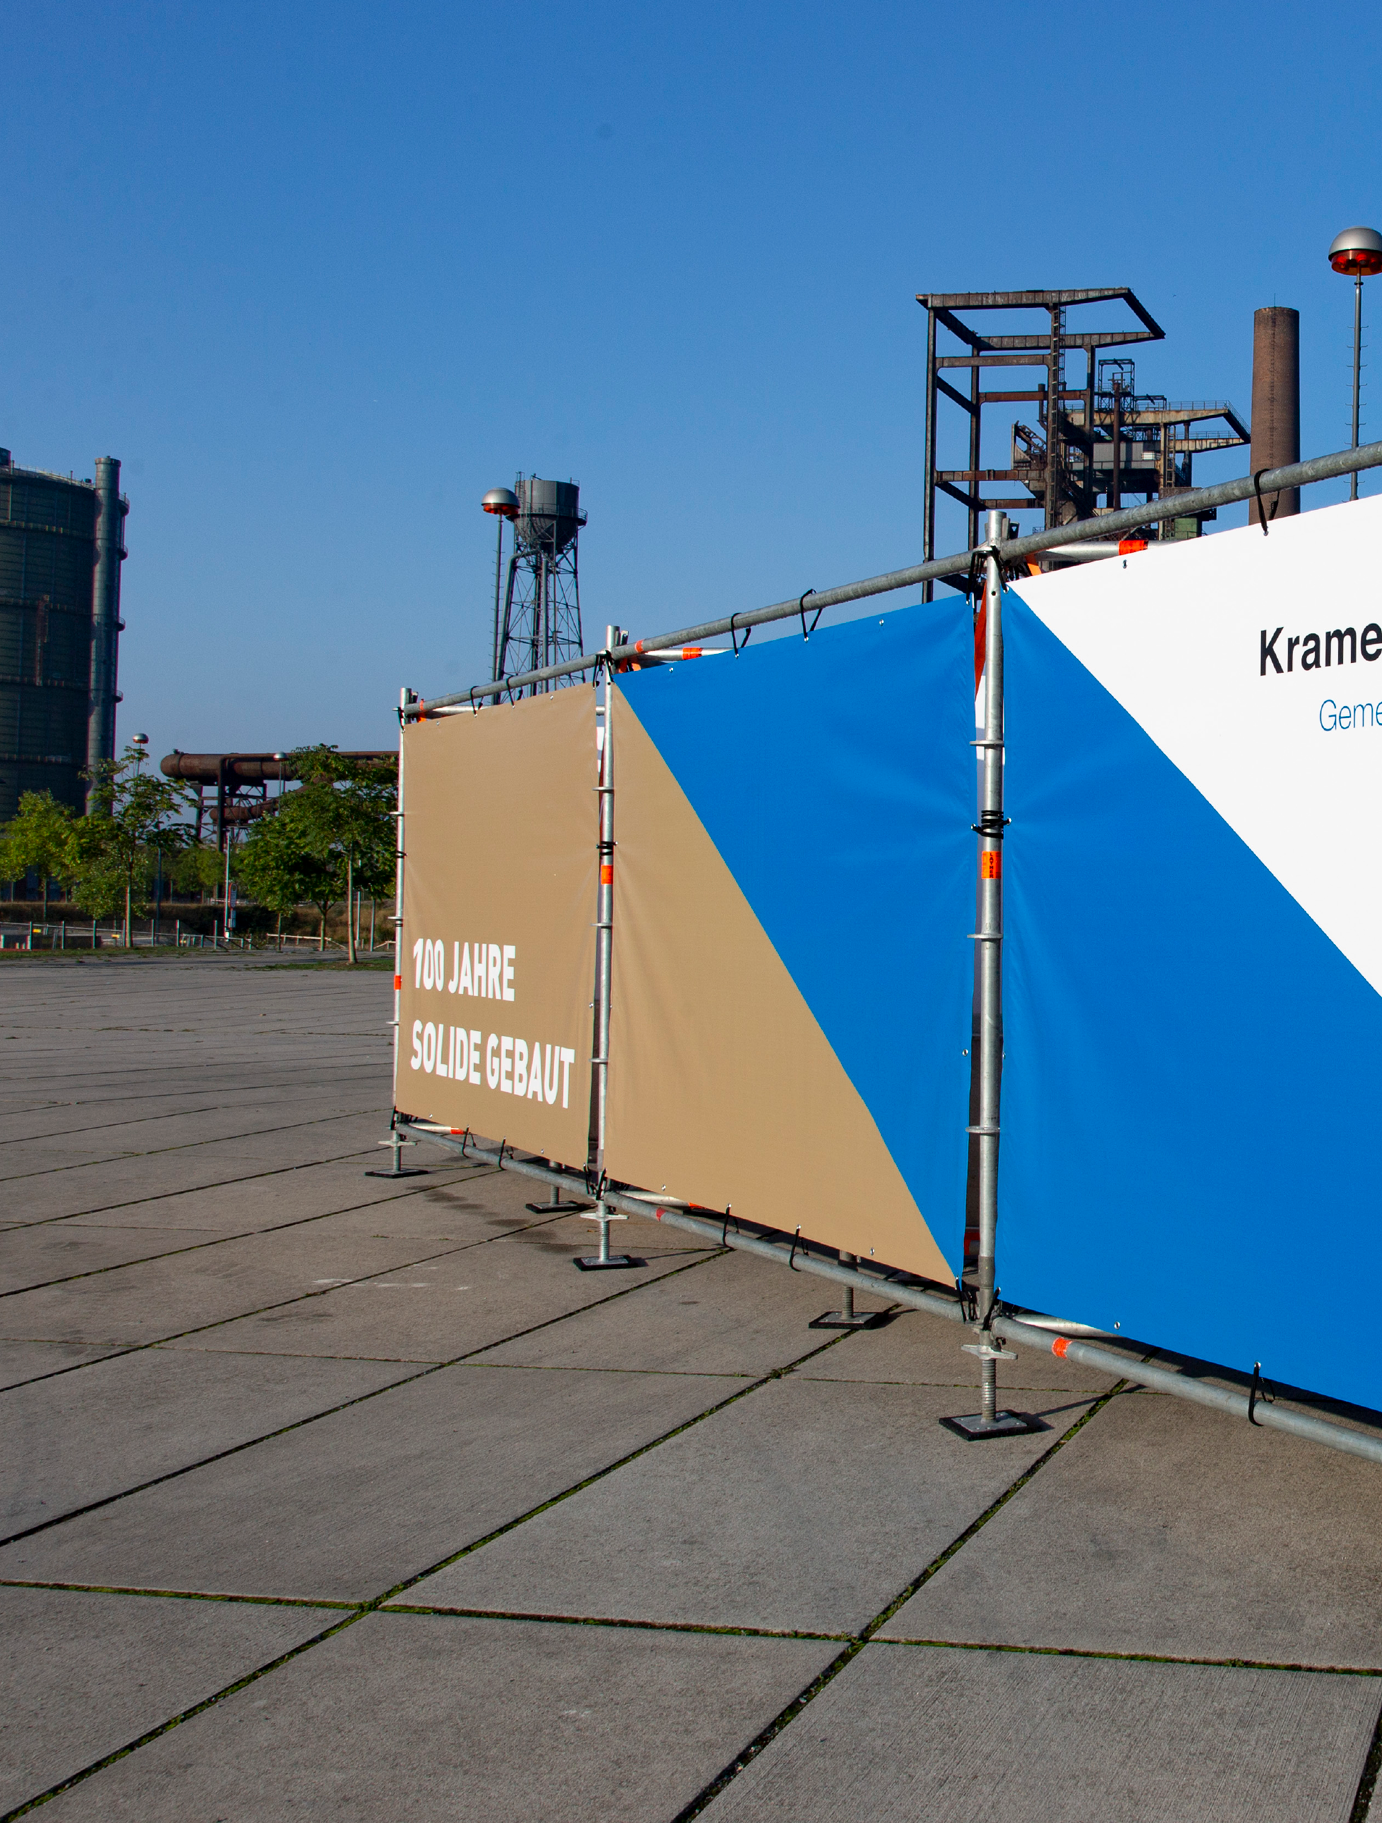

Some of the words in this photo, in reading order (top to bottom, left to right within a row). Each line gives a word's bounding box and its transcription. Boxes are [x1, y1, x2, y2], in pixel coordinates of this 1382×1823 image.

[413, 937, 445, 992] 100
[447, 941, 516, 1002] JAHRE
[410, 1019, 482, 1085] SOLIDE
[486, 1033, 576, 1109] GEBAUT
